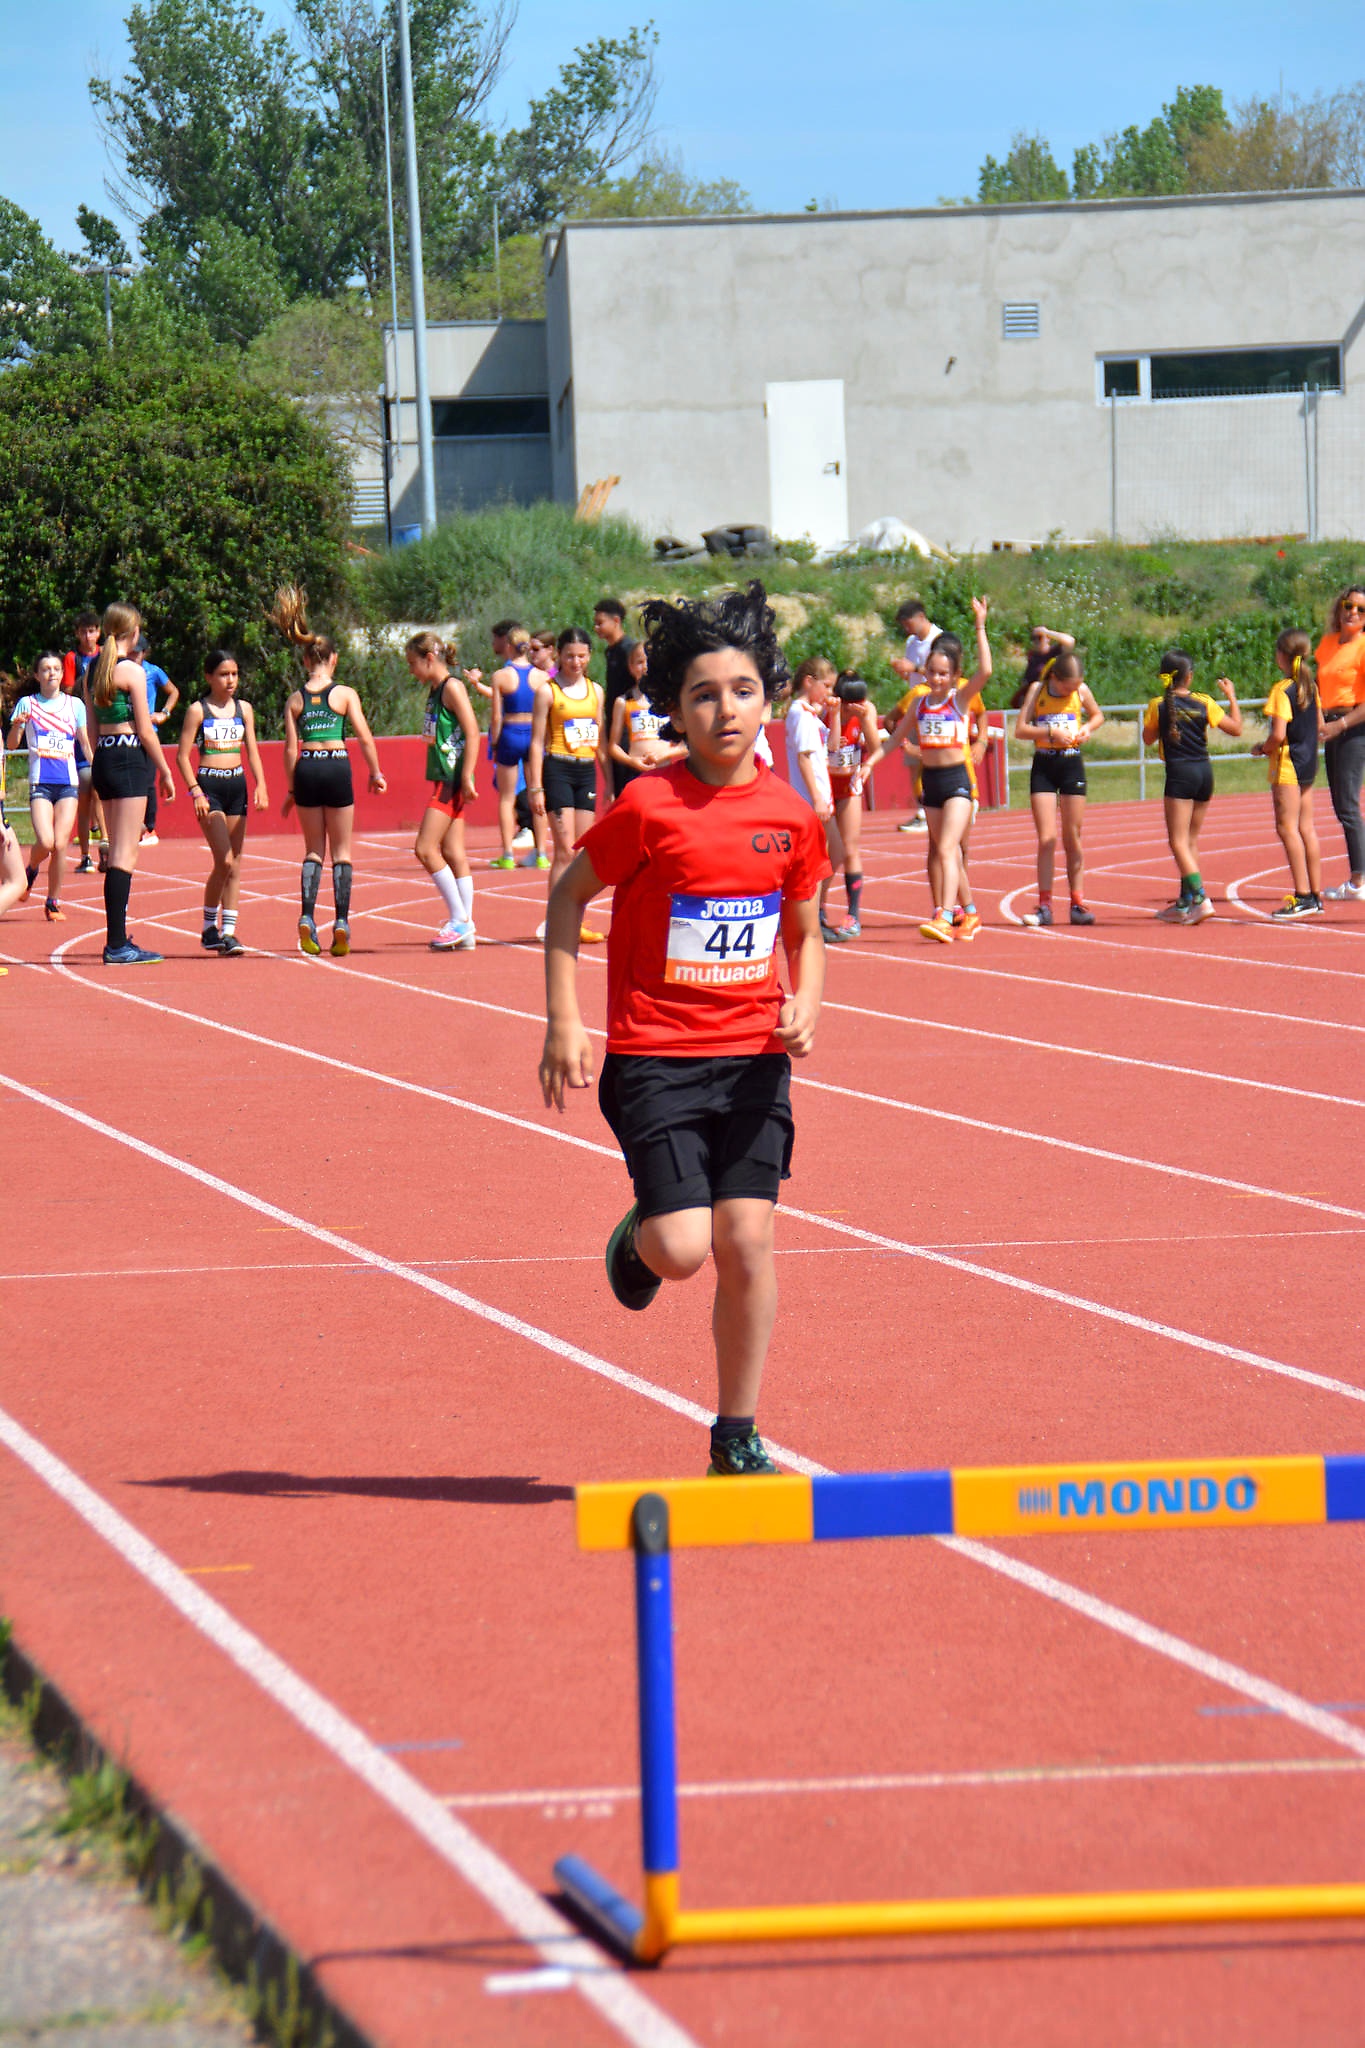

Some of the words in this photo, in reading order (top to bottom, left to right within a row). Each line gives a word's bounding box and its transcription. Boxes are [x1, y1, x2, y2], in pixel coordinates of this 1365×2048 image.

[214, 727, 238, 740] 178
[924, 721, 943, 735] 35
[48, 737, 65, 750] 96
[208, 768, 233, 778] PRO
[704, 922, 756, 960] 44
[1058, 1476, 1258, 1517] MONDO
